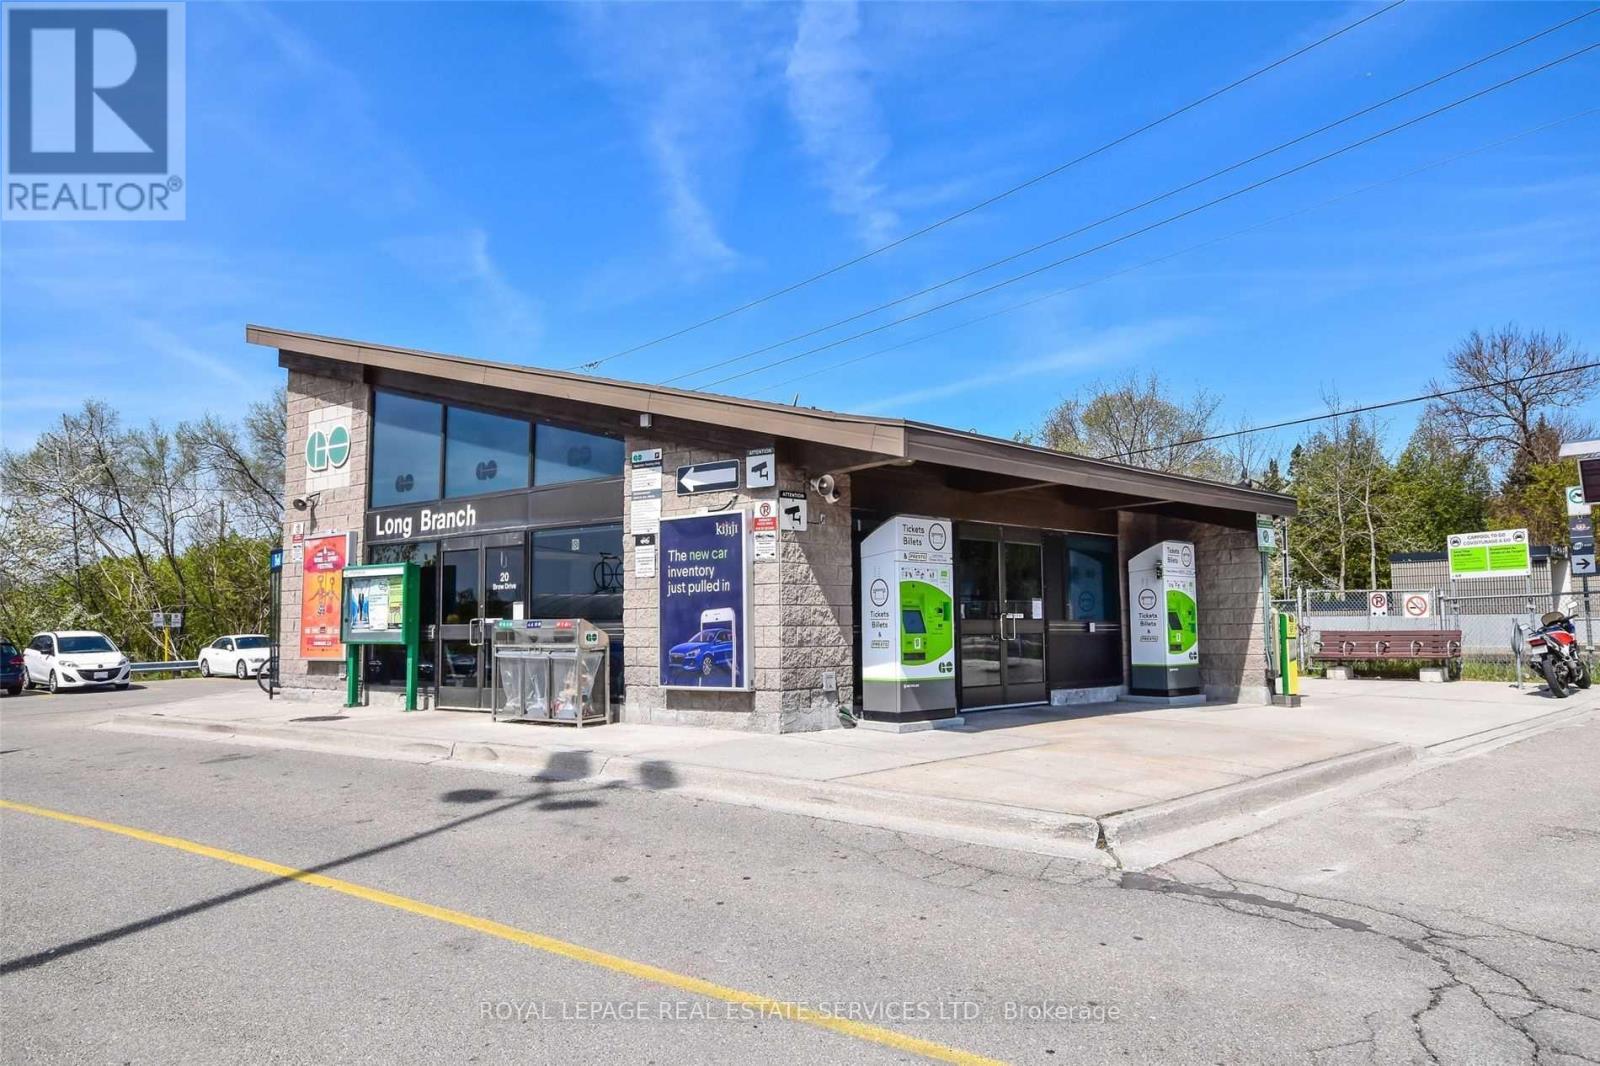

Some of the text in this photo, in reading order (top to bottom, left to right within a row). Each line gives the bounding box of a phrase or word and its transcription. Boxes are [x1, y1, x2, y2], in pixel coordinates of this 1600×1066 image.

[376, 504, 477, 538] Long Branch
[715, 521, 738, 536] kijiji
[902, 523, 925, 534] Tickets
[903, 537, 922, 546] Billets
[668, 549, 728, 562] The new car
[500, 572, 509, 582] 20
[667, 565, 715, 579] inventory
[667, 579, 731, 597] just pulled in
[872, 621, 888, 629] Billets
[938, 661, 953, 674] GO
